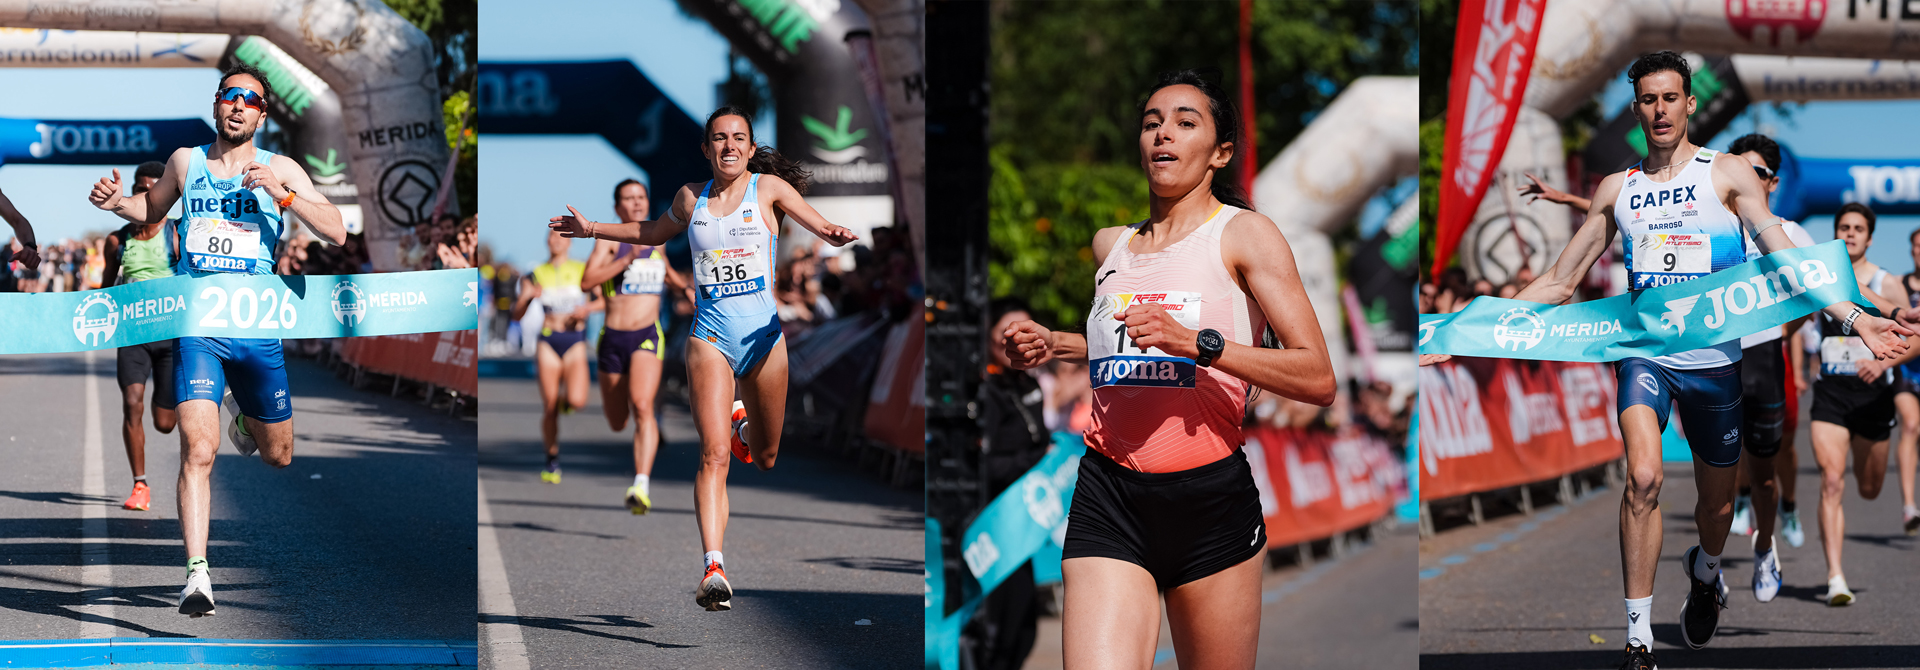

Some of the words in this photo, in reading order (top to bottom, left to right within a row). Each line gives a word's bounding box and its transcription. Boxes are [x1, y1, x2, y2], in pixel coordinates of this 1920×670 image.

[29, 122, 158, 158] Joma
[190, 192, 259, 219] nerja
[1630, 184, 1697, 210] CAPEX
[1648, 220, 1683, 231] BARROSO
[207, 236, 233, 256] 80
[202, 255, 246, 270] Joma
[1663, 252, 1677, 272] 9
[711, 263, 747, 283] 136
[368, 290, 428, 308] MÉRIDA
[714, 280, 759, 298] Joma
[1131, 293, 1168, 304] RFEA
[1703, 259, 1838, 330] Joma
[122, 294, 187, 321] MÉRIDA
[198, 286, 298, 331] 2026
[382, 306, 417, 314] AYUNTAMIENTO
[135, 314, 173, 326] AYUNTAMIENTO
[1549, 318, 1623, 338] MÉRIDA
[1563, 335, 1608, 343] AYUNTAMIENTO
[1104, 359, 1179, 382] Joma
[190, 378, 215, 386] nerja
